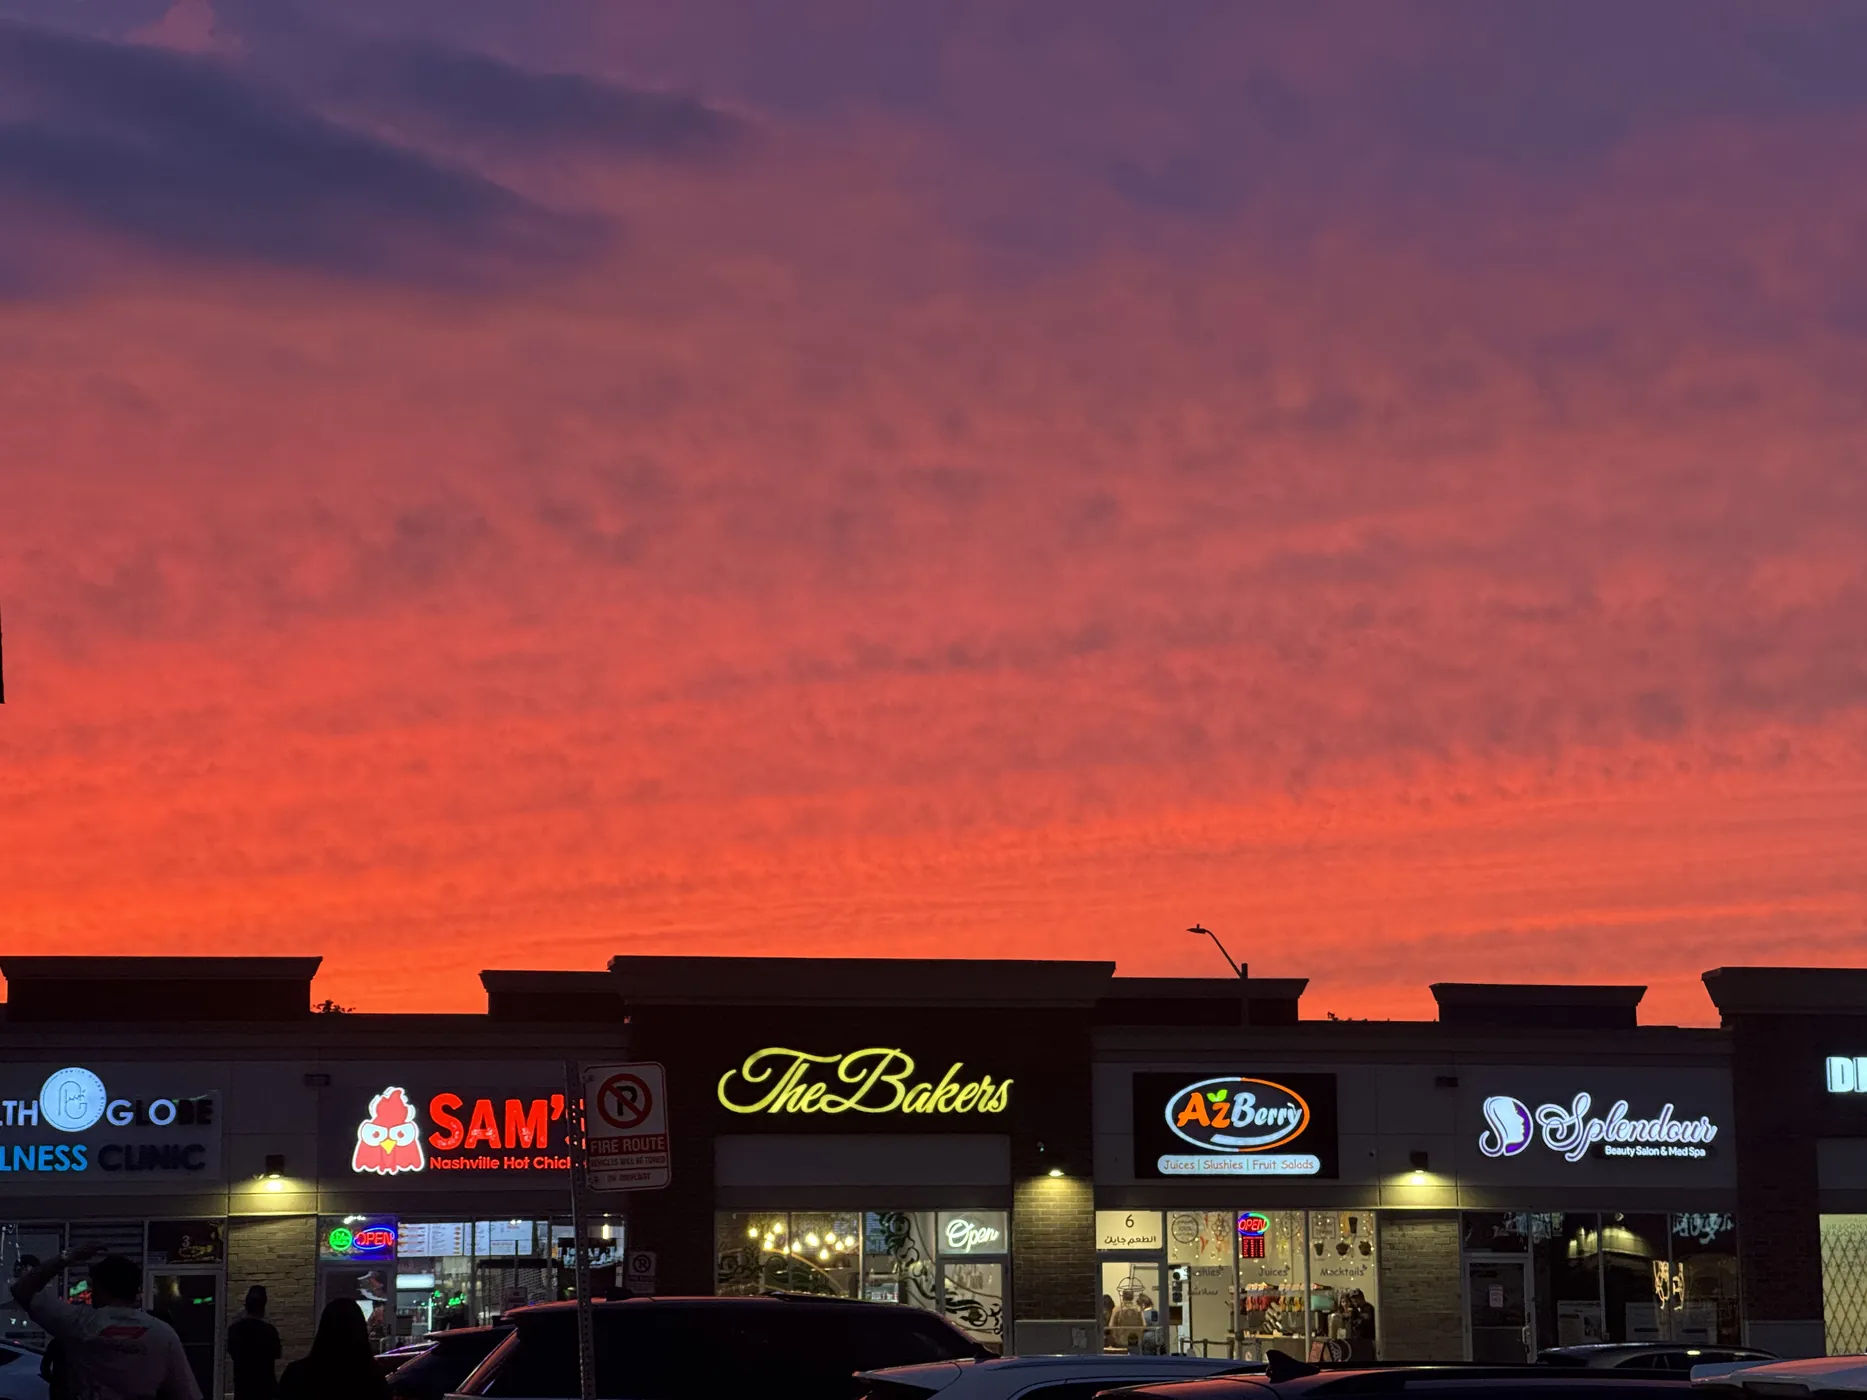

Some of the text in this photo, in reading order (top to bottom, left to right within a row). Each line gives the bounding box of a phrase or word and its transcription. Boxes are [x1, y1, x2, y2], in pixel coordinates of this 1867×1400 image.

[717, 1047, 1014, 1114] The Bakers
[0, 1098, 213, 1126] TH GLOBE
[1177, 1091, 1303, 1146] AzBerry
[428, 1093, 586, 1151] SAM'
[1535, 1091, 1718, 1162] Splendour
[590, 1136, 665, 1154] FIRE ROUTE
[1604, 1145, 1706, 1158] Beauty Salon & Med Spa
[97, 1144, 205, 1170] CLINIC
[430, 1156, 500, 1169] Nashville
[504, 1156, 531, 1169] Hot
[1163, 1159, 1314, 1170] Juices Slushies Fruit Salads
[1125, 1214, 1135, 1228] 6
[1238, 1218, 1267, 1231] OPEN
[181, 1234, 191, 1248] 3
[356, 1231, 393, 1246] OPEN
[946, 1219, 1000, 1253] Open
[1258, 1267, 1289, 1277] Juices
